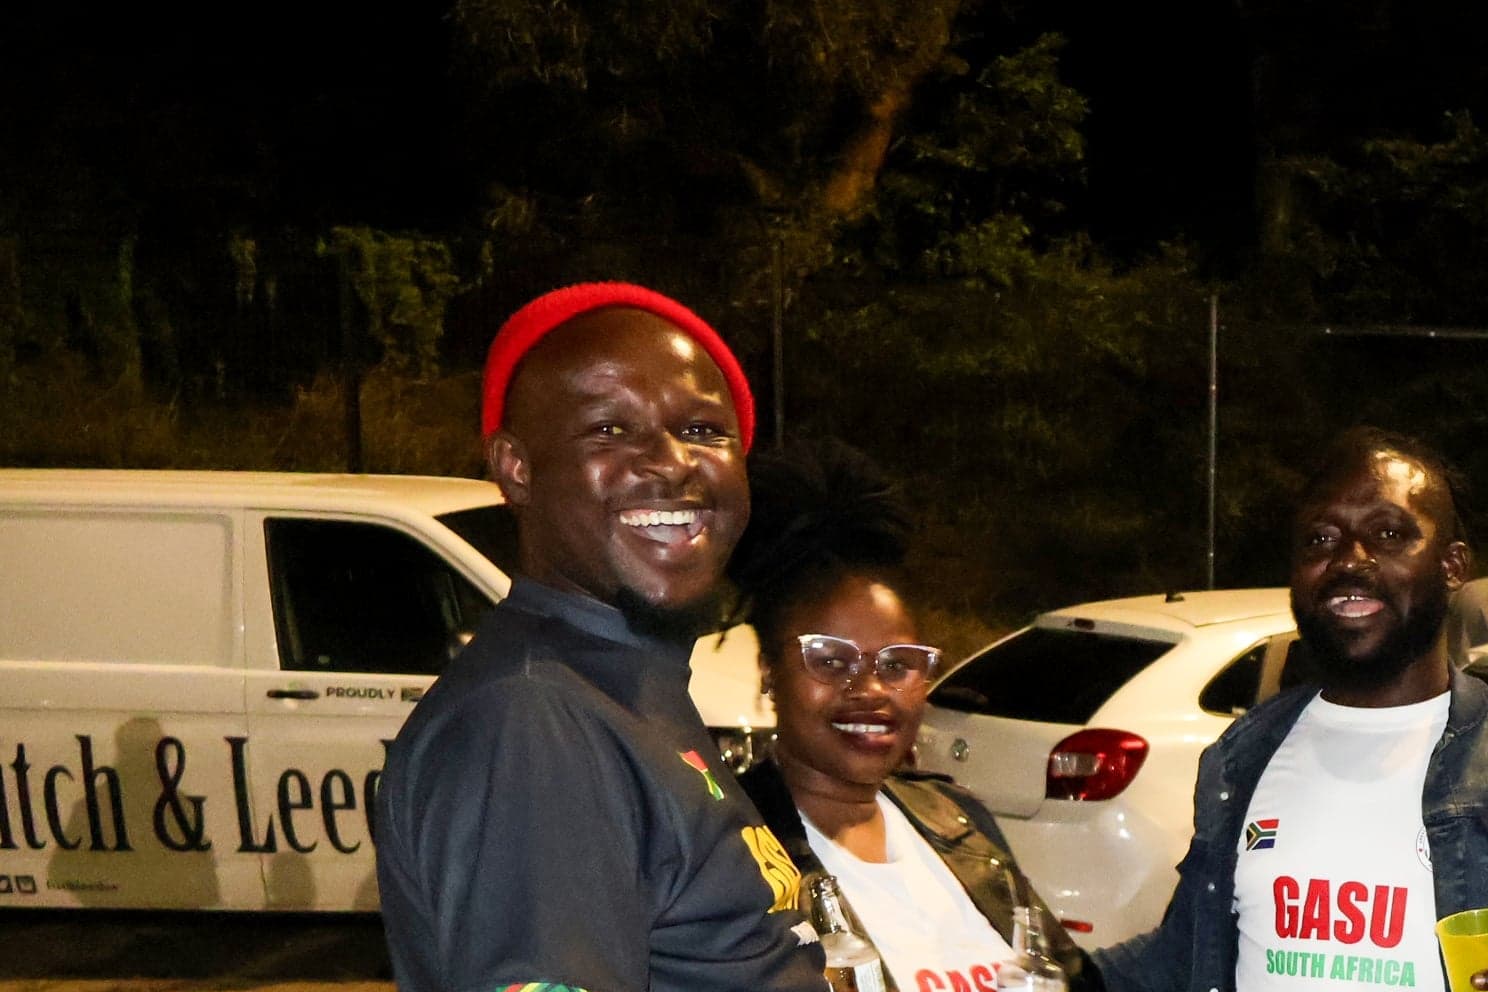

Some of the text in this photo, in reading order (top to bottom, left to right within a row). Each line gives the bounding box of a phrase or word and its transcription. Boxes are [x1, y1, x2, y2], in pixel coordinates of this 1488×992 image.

[326, 686, 396, 699] PROUDLY
[153, 735, 212, 852] &
[1273, 875, 1409, 950] GASU
[1265, 948, 1417, 988] SOUTH AFRICA
